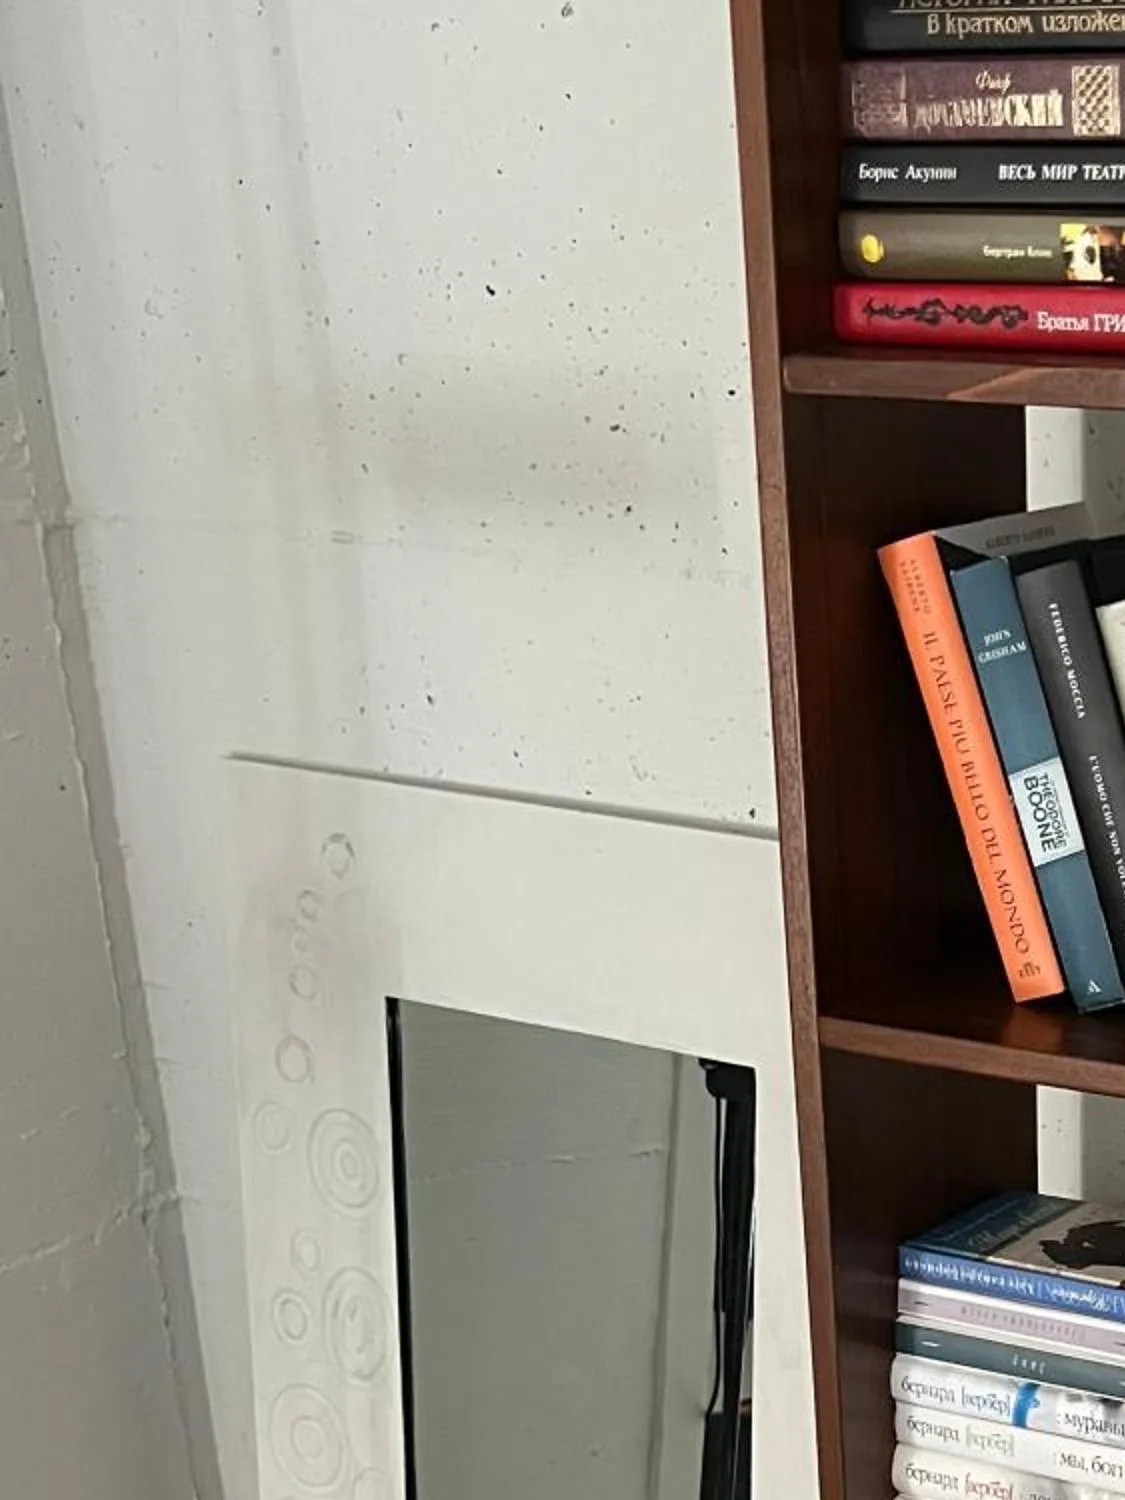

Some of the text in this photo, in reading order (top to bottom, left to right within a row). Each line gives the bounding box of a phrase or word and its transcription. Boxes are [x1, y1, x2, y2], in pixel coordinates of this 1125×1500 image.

[946, 13, 1033, 39] кратком
[859, 164, 957, 182] Борис Акунин
[999, 165, 1036, 180] ВЕСЬ
[1041, 165, 1077, 180] МИР
[1037, 312, 1089, 331] Братья
[925, 652, 961, 714] PAESE
[1065, 667, 1087, 718] MOCCIA
[955, 747, 992, 822] BELLO
[1034, 770, 1069, 848] THEODORE
[1023, 774, 1057, 852] BOONE
[978, 825, 1004, 864] DEL
[990, 866, 1034, 956] MONDO
